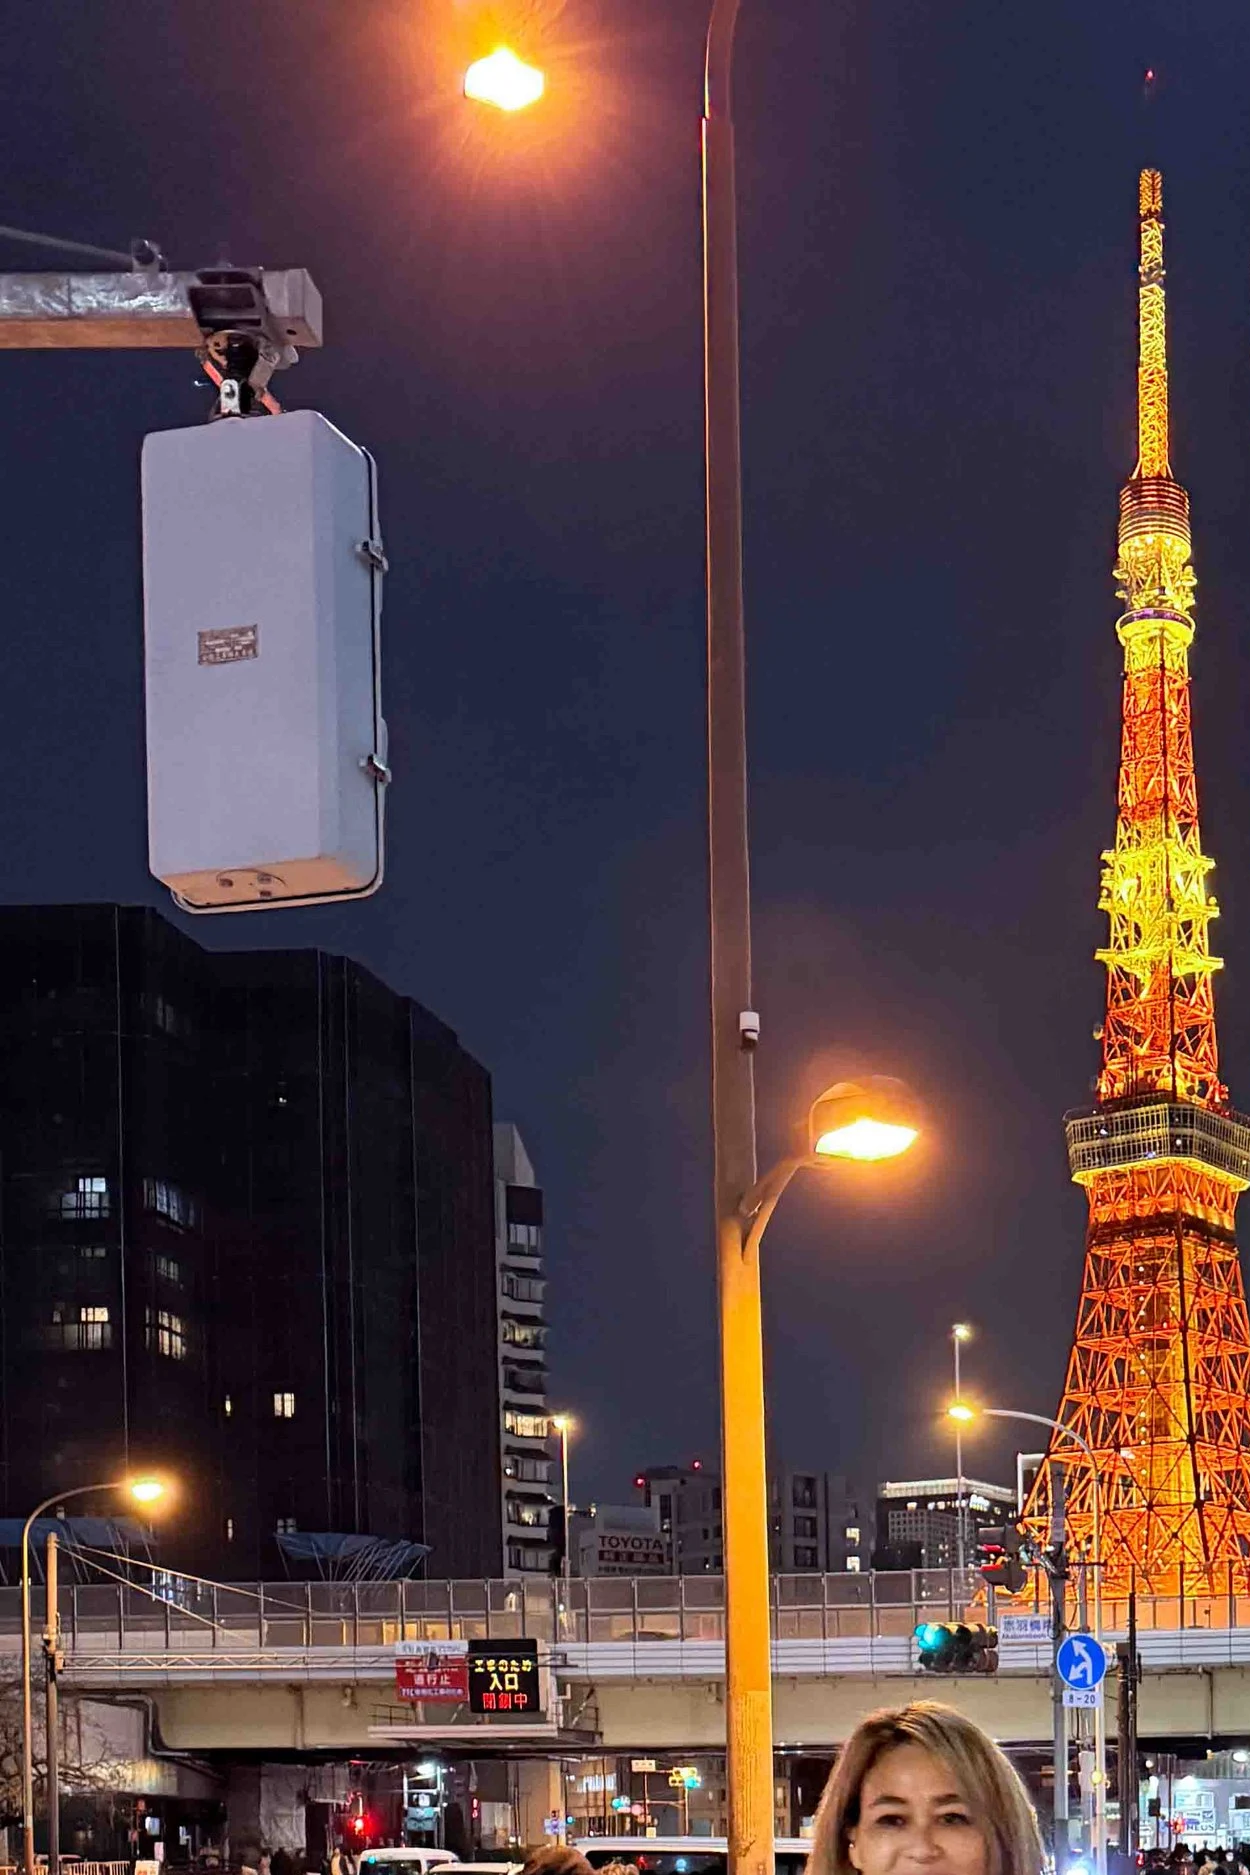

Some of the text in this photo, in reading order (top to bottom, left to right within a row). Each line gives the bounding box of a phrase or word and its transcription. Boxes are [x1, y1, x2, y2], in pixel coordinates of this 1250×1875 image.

[598, 1535, 663, 1550] TOYOTA
[474, 1659, 532, 1673] 工事のため
[489, 1673, 519, 1691] 入口
[483, 1692, 528, 1710] 閉鎖中
